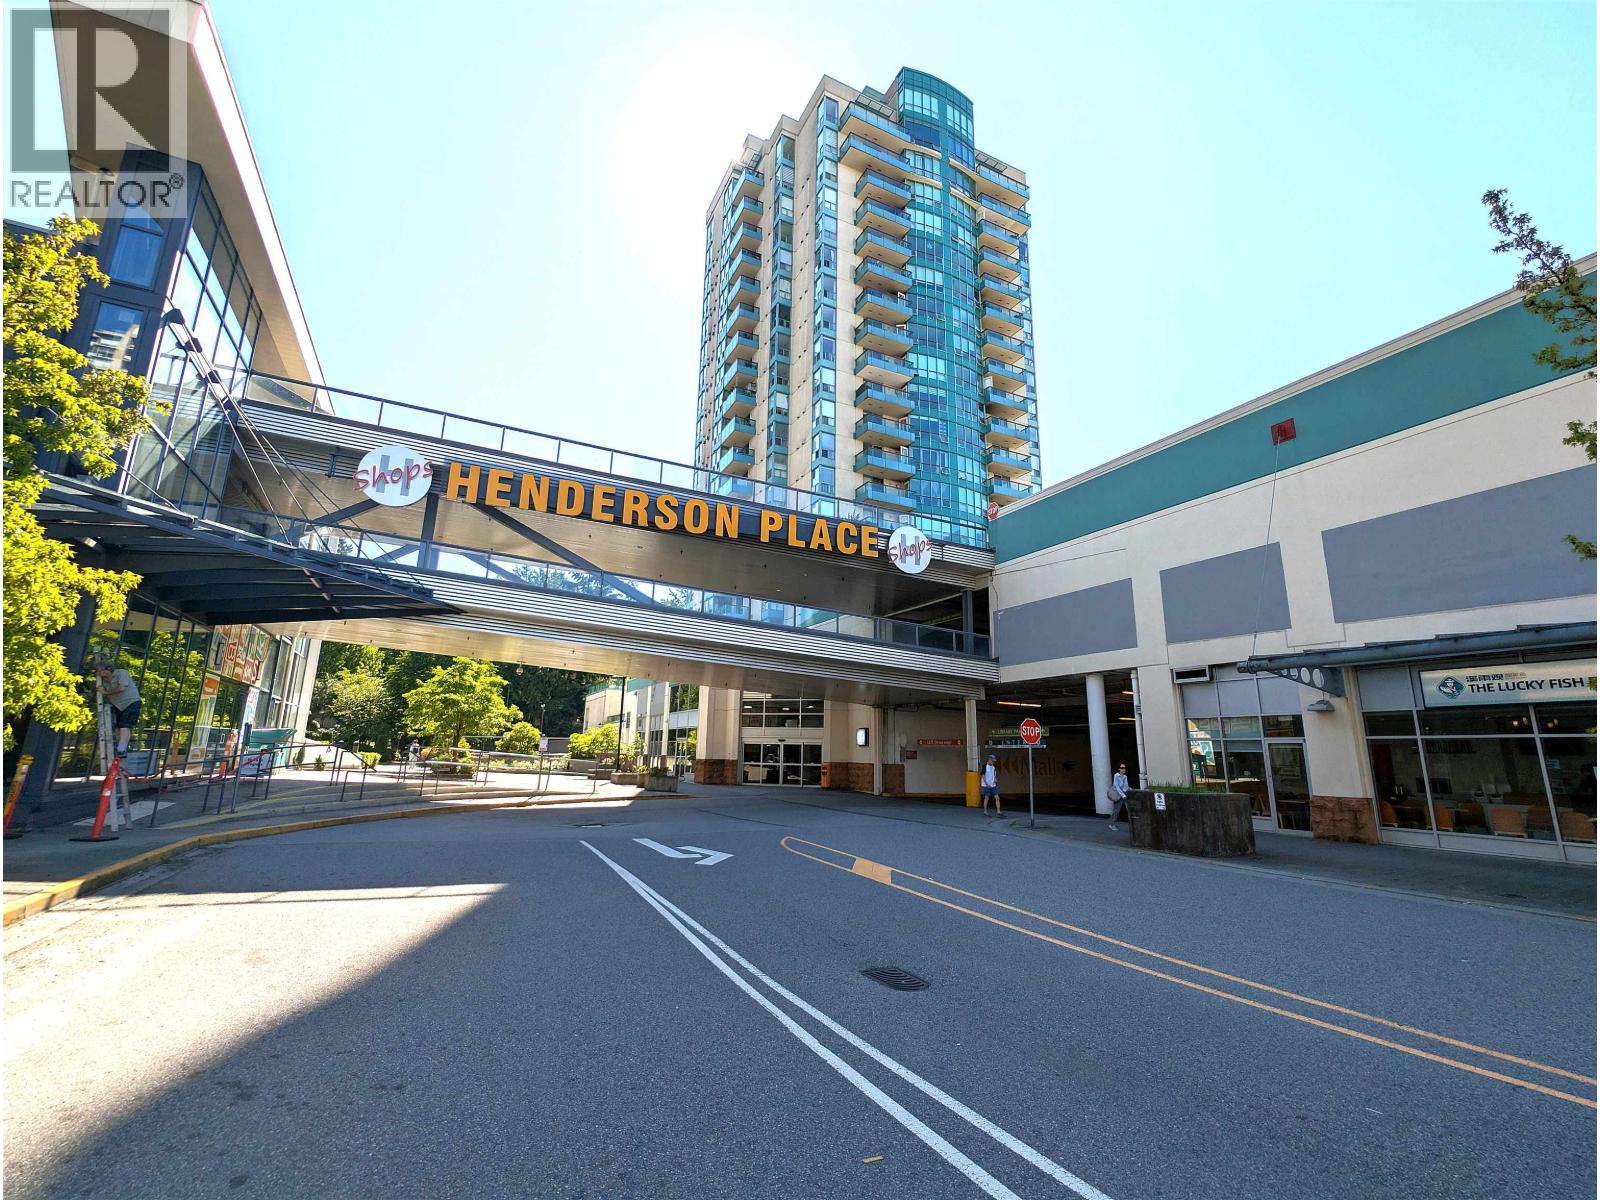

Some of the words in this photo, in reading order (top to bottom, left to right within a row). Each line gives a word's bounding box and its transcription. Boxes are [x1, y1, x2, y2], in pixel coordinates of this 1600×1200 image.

[445, 462, 740, 539] HENDERSON
[760, 510, 880, 558] PLACE
[1468, 683, 1495, 693] THE
[1499, 680, 1545, 692] LUCKY
[1549, 677, 1585, 688] FISH
[1022, 726, 1040, 736] STOP
